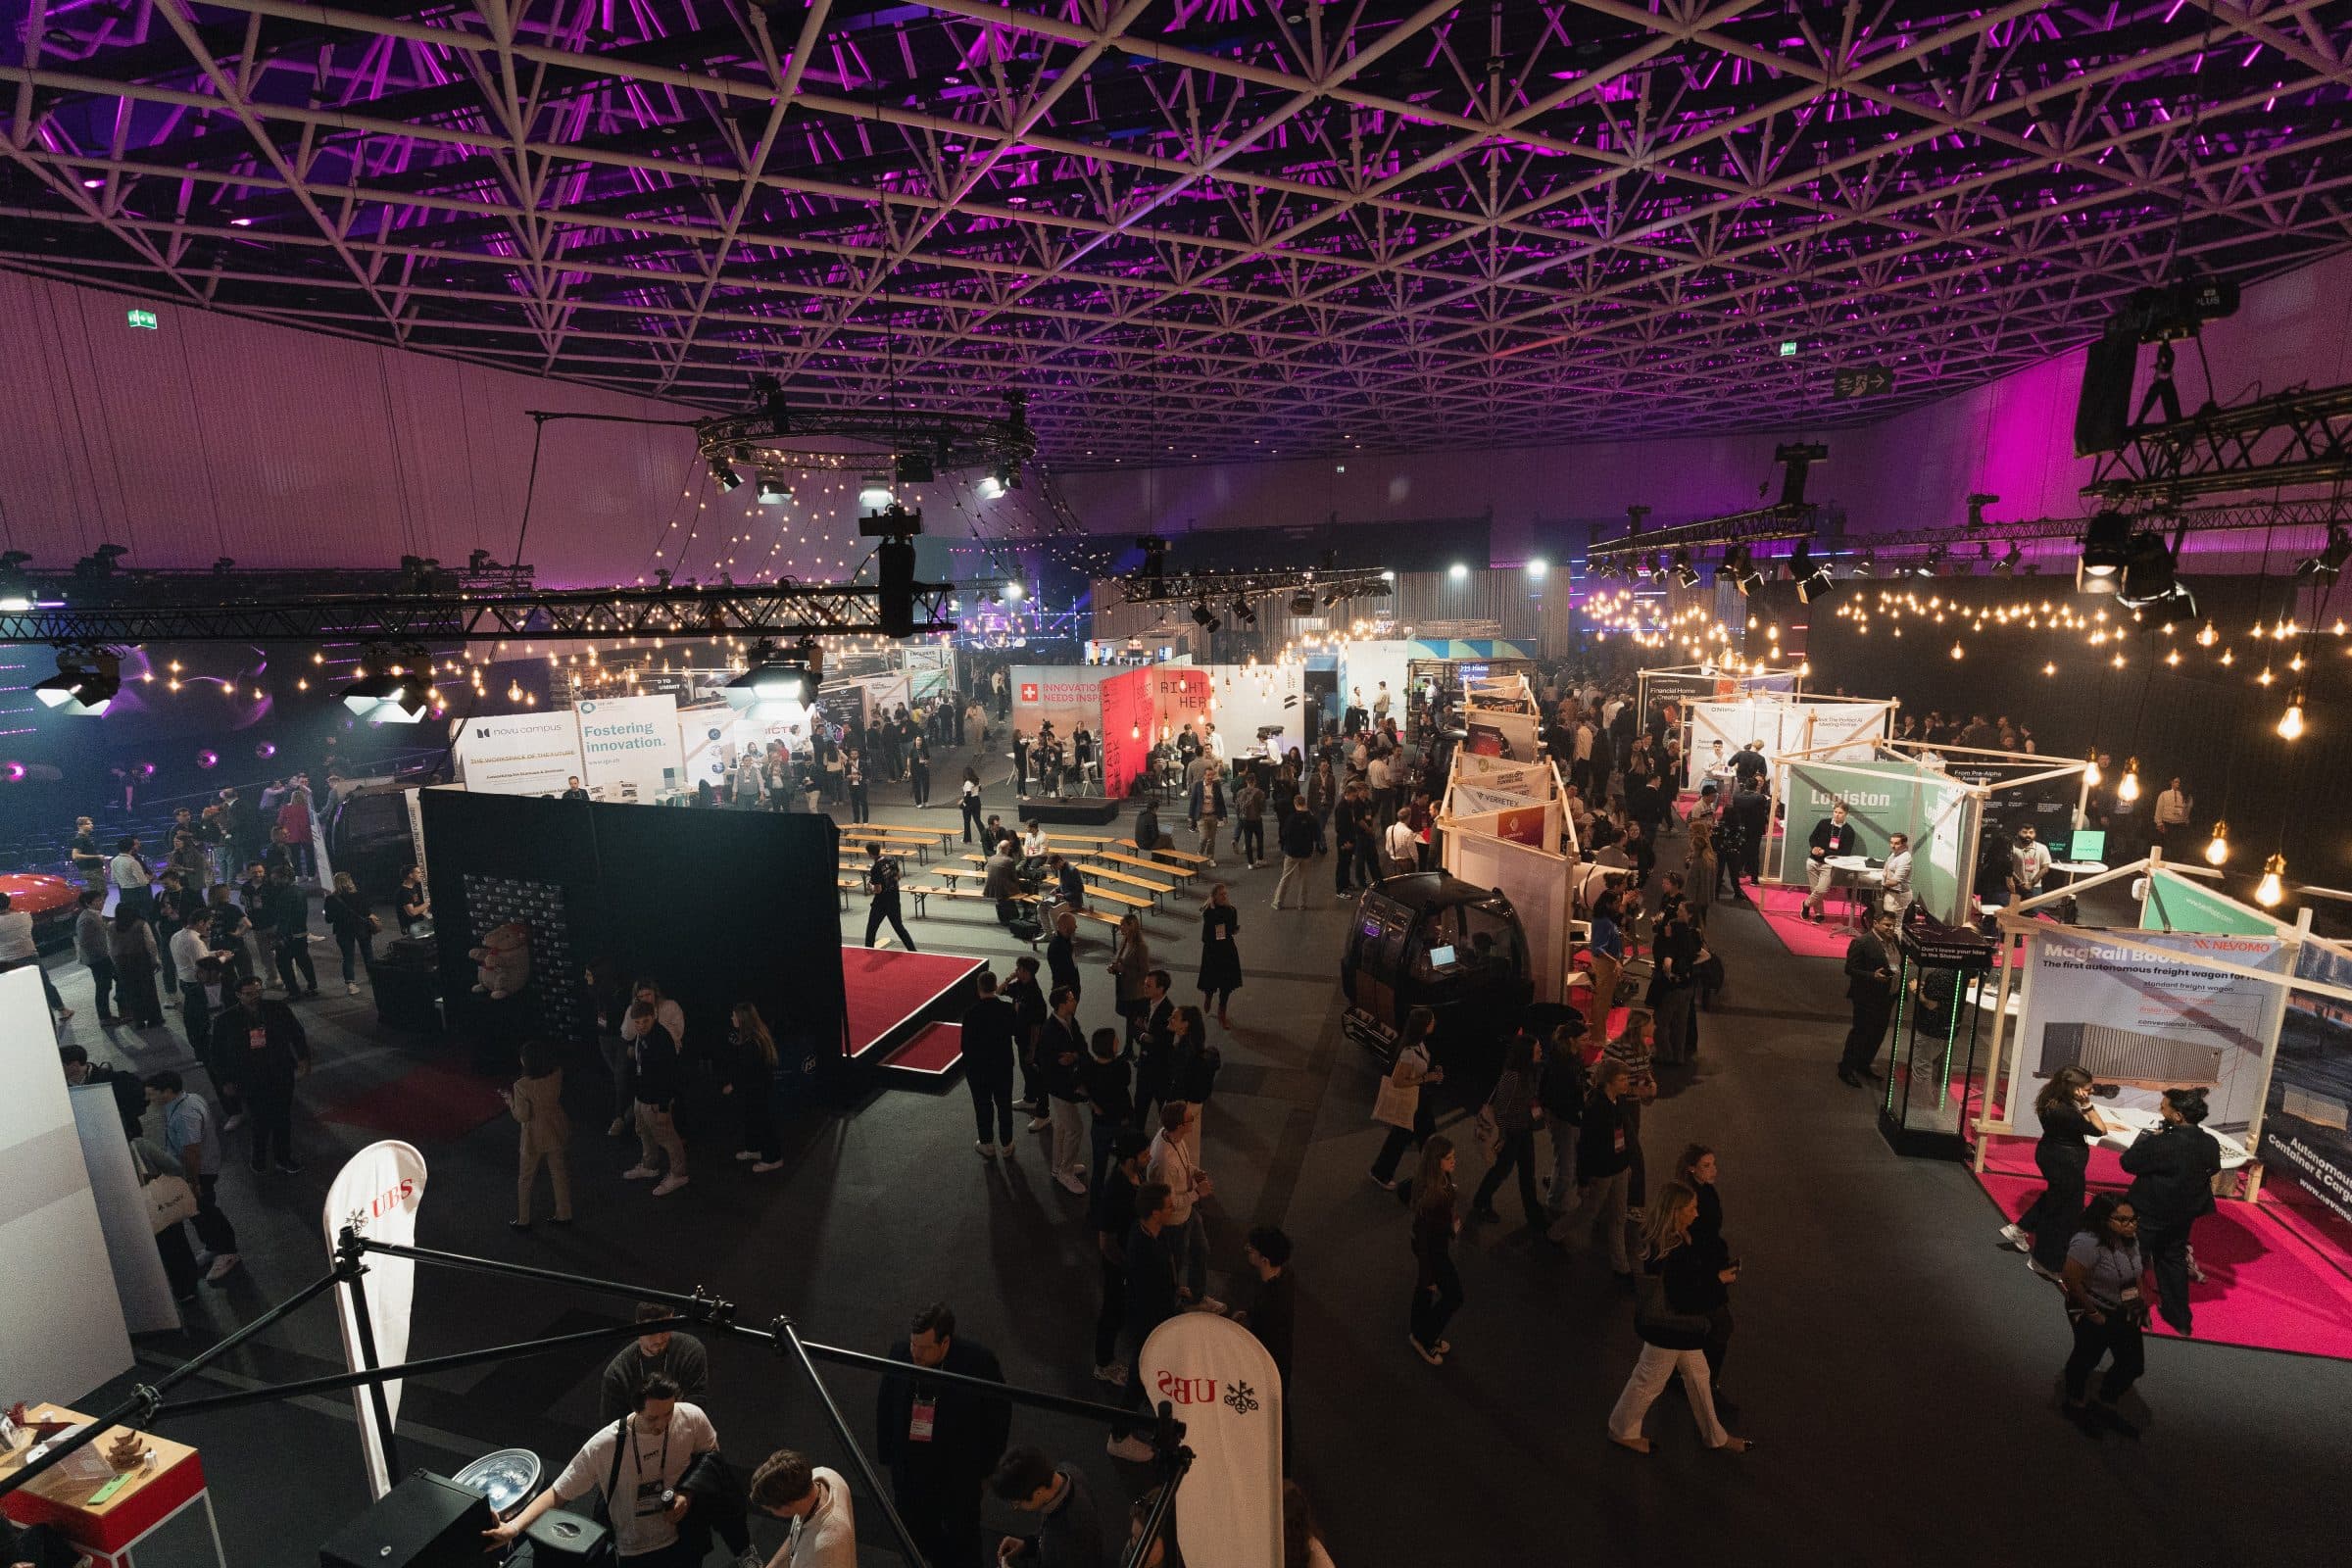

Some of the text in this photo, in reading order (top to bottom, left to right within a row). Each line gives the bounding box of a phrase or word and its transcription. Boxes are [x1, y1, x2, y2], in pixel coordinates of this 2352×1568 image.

[1043, 682, 1102, 692] INNOVATIO
[1043, 693, 1074, 703] NEEDS
[584, 722, 654, 737] Fostering
[586, 737, 666, 753] innovation.
[1485, 793, 1519, 808] VERRETEX
[1811, 790, 1890, 807] Logiston
[2044, 944, 2128, 962] MagRail
[2212, 940, 2271, 953] NEVOMO
[2063, 961, 2083, 970] first
[2084, 962, 2152, 974] autonomous
[2153, 966, 2190, 978] freight
[2190, 970, 2230, 980] wagon
[2180, 982, 2205, 991] freight
[2137, 1019, 2187, 1028] conventional
[2268, 1134, 2316, 1174] Container
[2315, 1168, 2323, 1181] &
[372, 1178, 414, 1218] UBS
